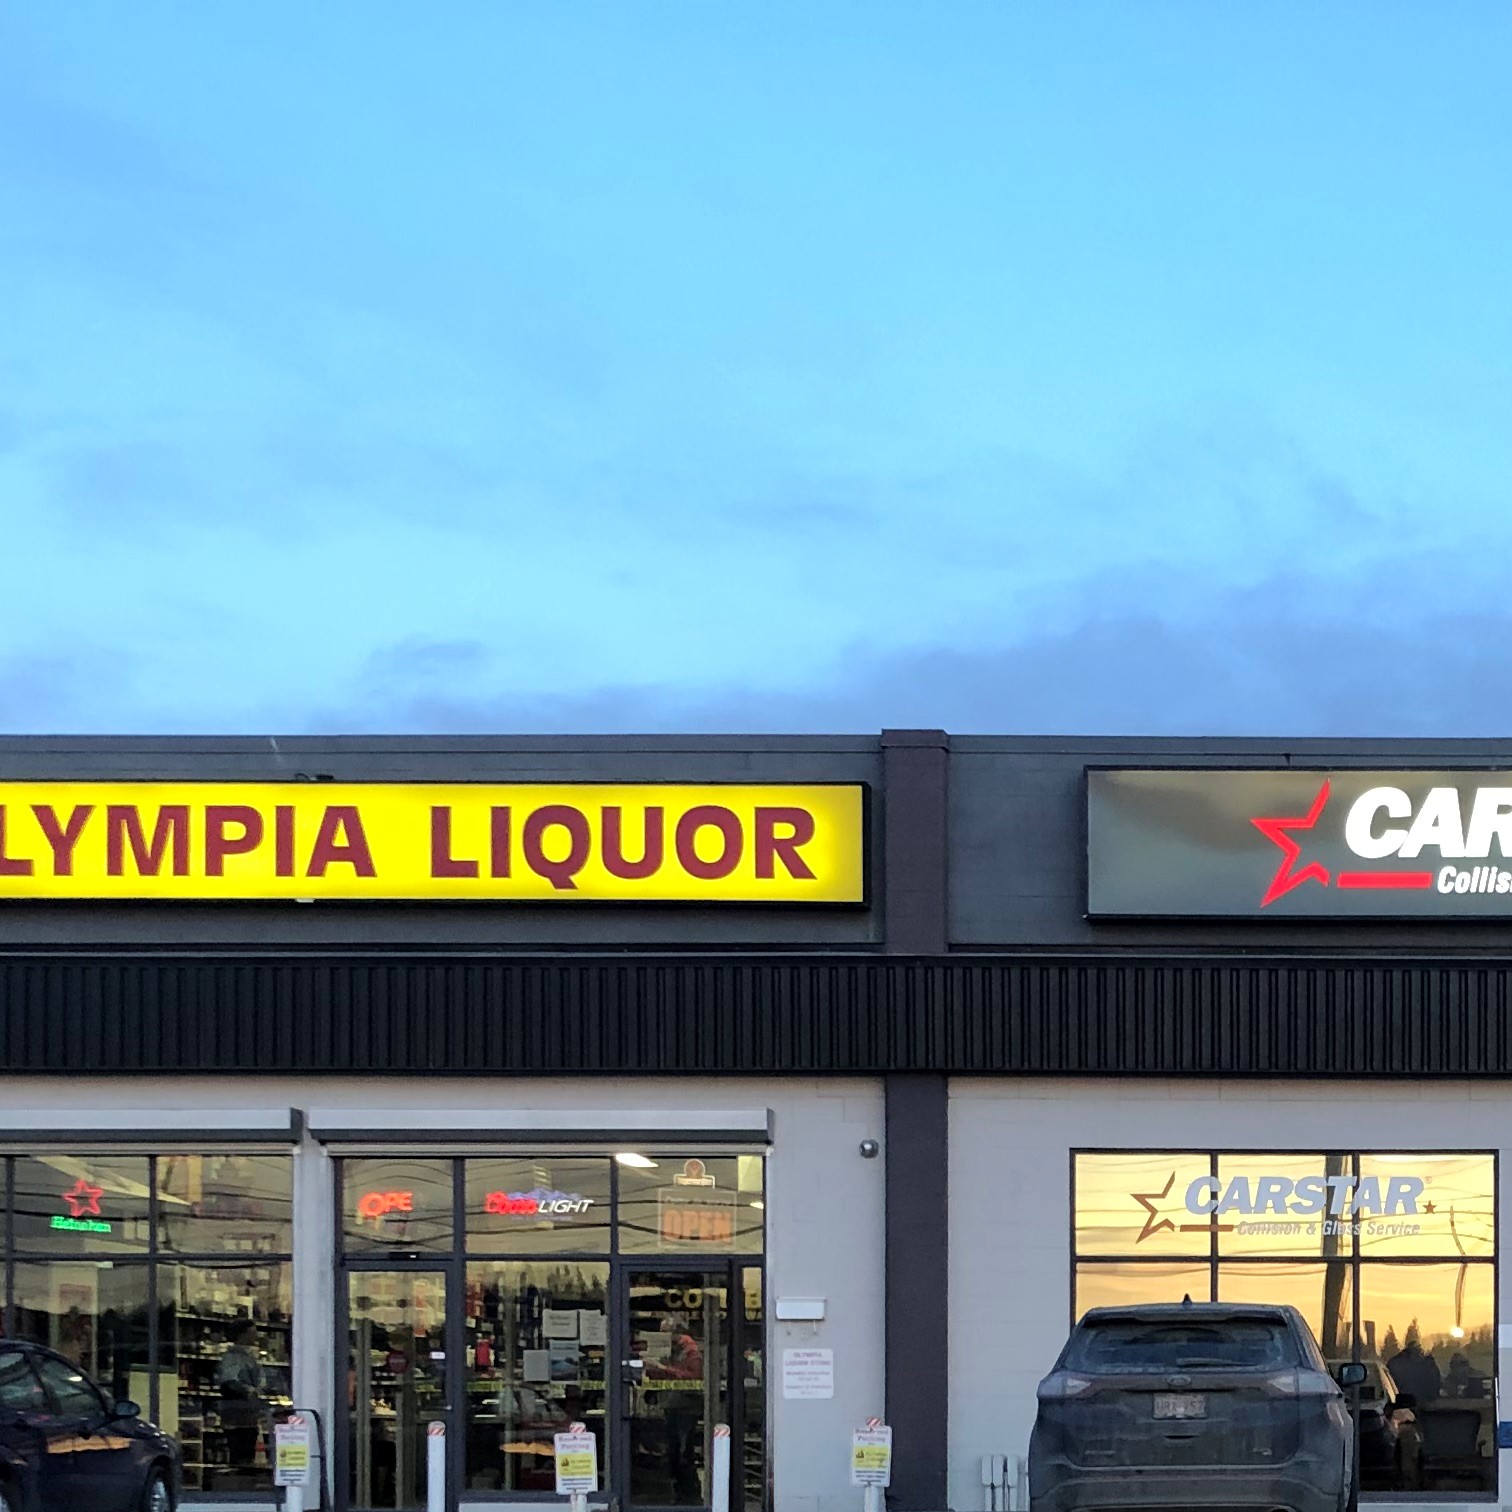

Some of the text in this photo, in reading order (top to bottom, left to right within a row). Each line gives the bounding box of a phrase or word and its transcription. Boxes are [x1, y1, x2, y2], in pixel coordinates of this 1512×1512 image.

[430, 805, 818, 890] LIQUOR
[538, 1199, 594, 1213] LIGHT
[1184, 1175, 1425, 1215] CARSTAR
[1322, 1221, 1360, 1236] Glass
[1367, 1222, 1421, 1235] Service
